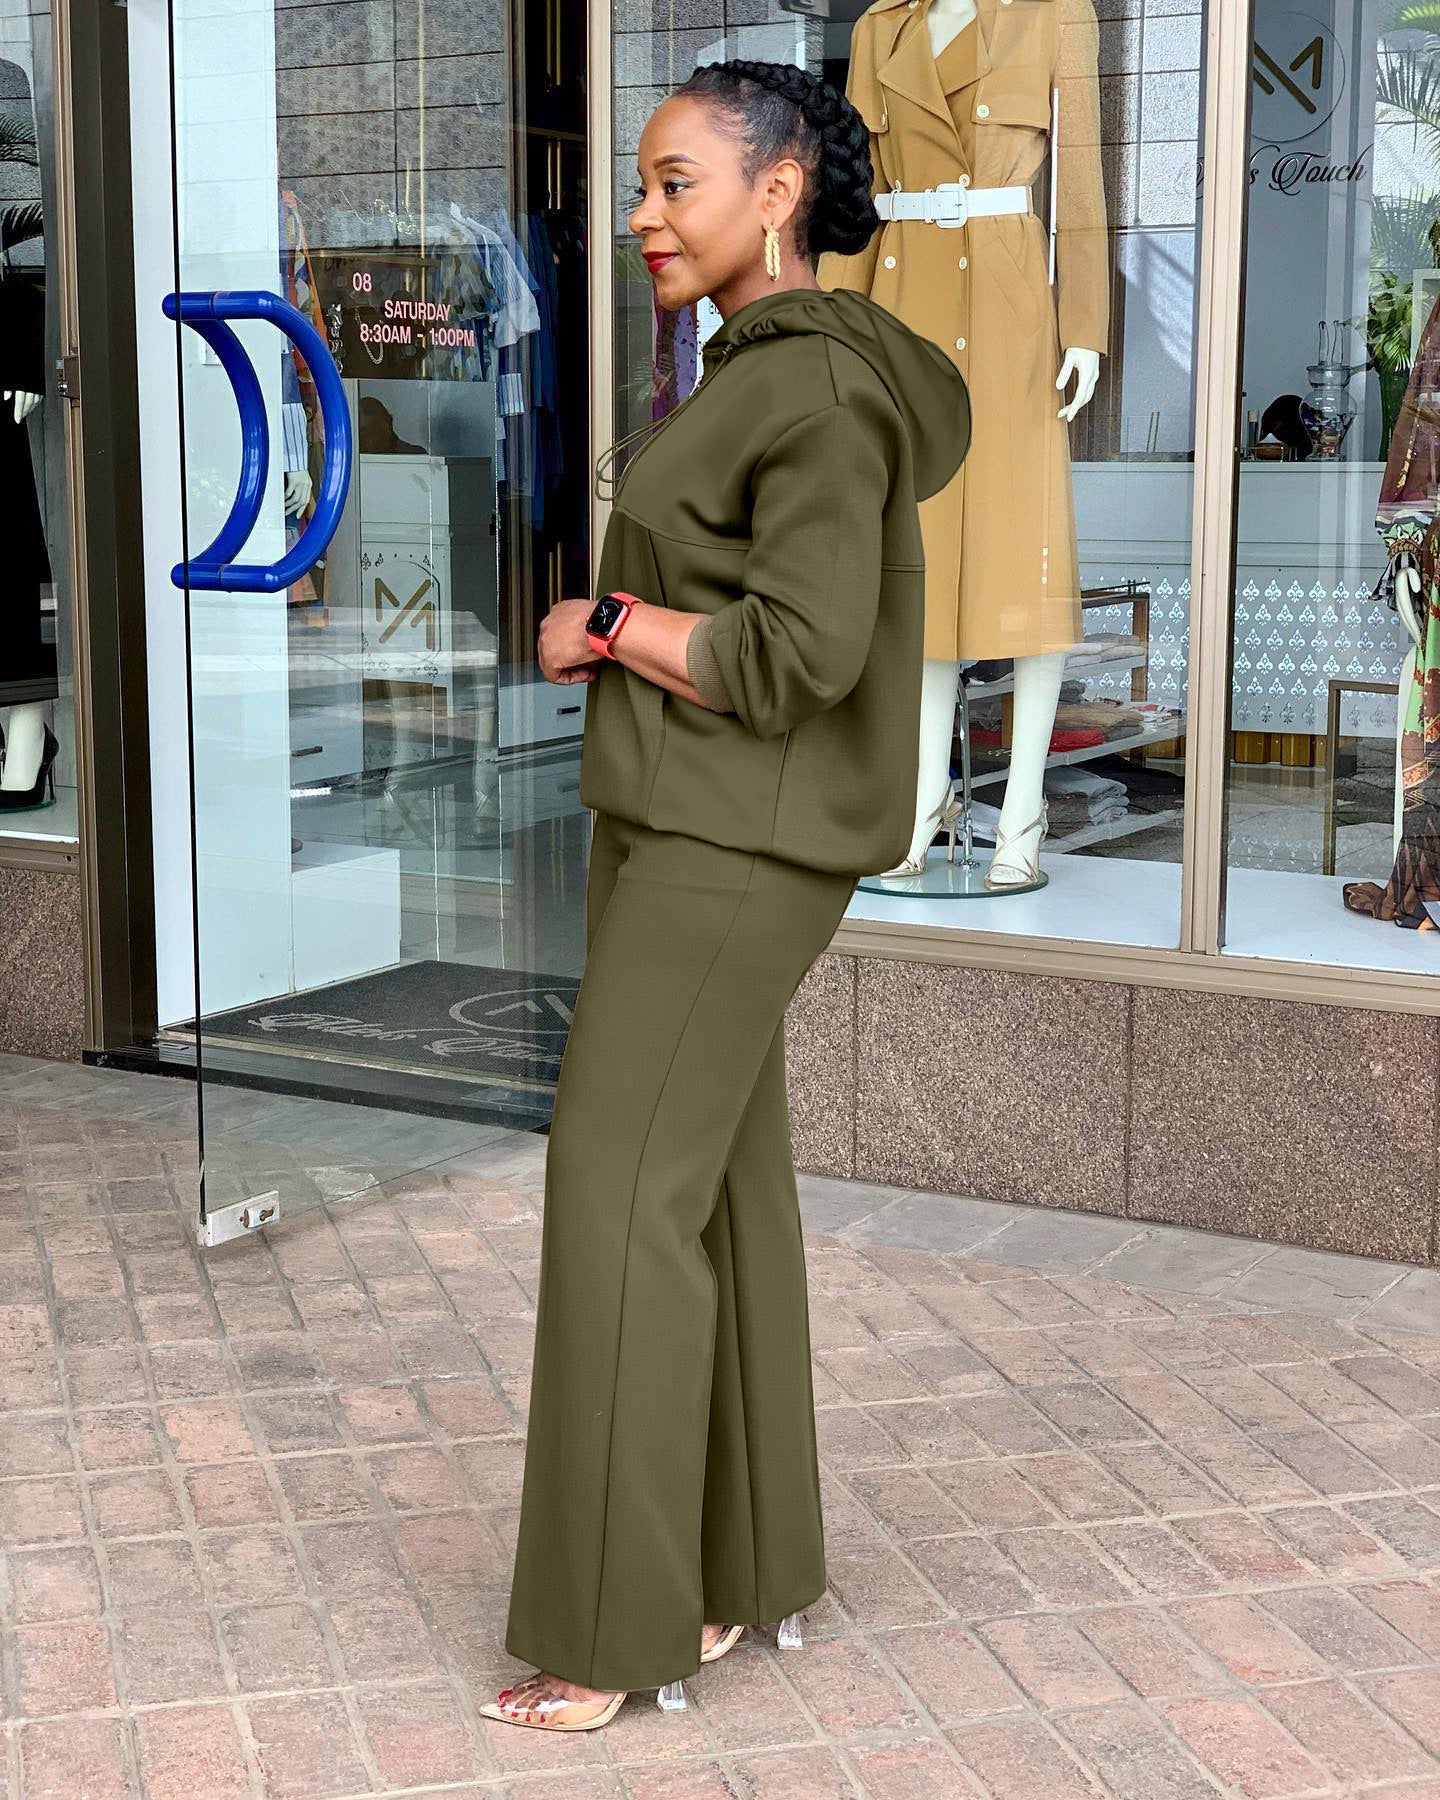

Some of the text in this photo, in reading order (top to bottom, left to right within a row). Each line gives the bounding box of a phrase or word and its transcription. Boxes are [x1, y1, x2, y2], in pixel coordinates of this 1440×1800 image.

[1268, 144, 1374, 197] Touch
[352, 272, 373, 293] 08
[384, 299, 451, 321] SATURDAY
[360, 322, 412, 345] 8:30AM
[429, 327, 475, 348] 1:00PM
